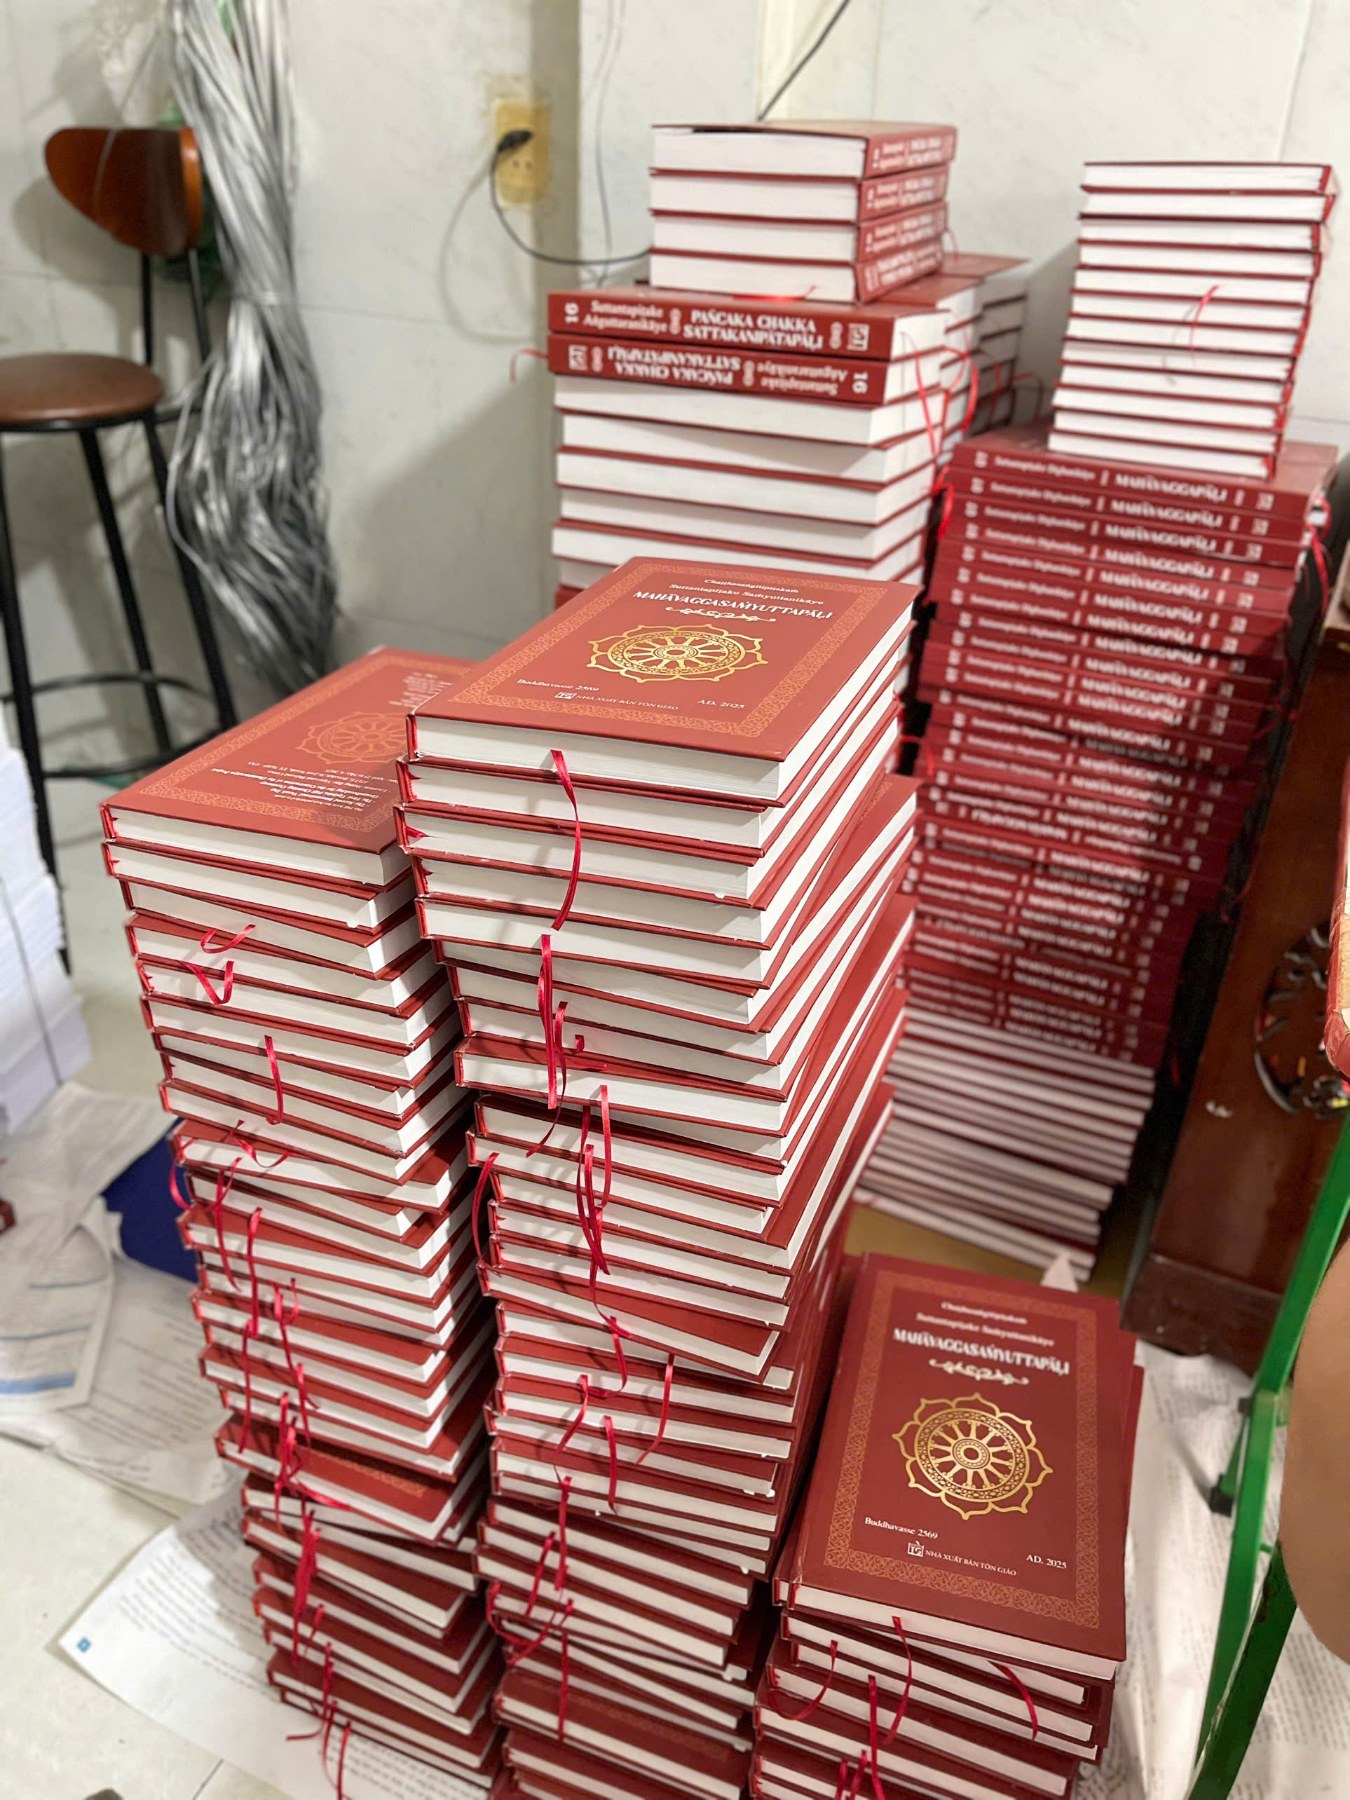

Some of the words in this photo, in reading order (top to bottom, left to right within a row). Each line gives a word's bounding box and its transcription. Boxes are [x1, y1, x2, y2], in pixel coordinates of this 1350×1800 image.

[865, 1517, 915, 1535] Buddhavasse
[918, 1529, 938, 1539] 2569
[1026, 1554, 1043, 1564] AD.
[1046, 1558, 1067, 1569] 2025
